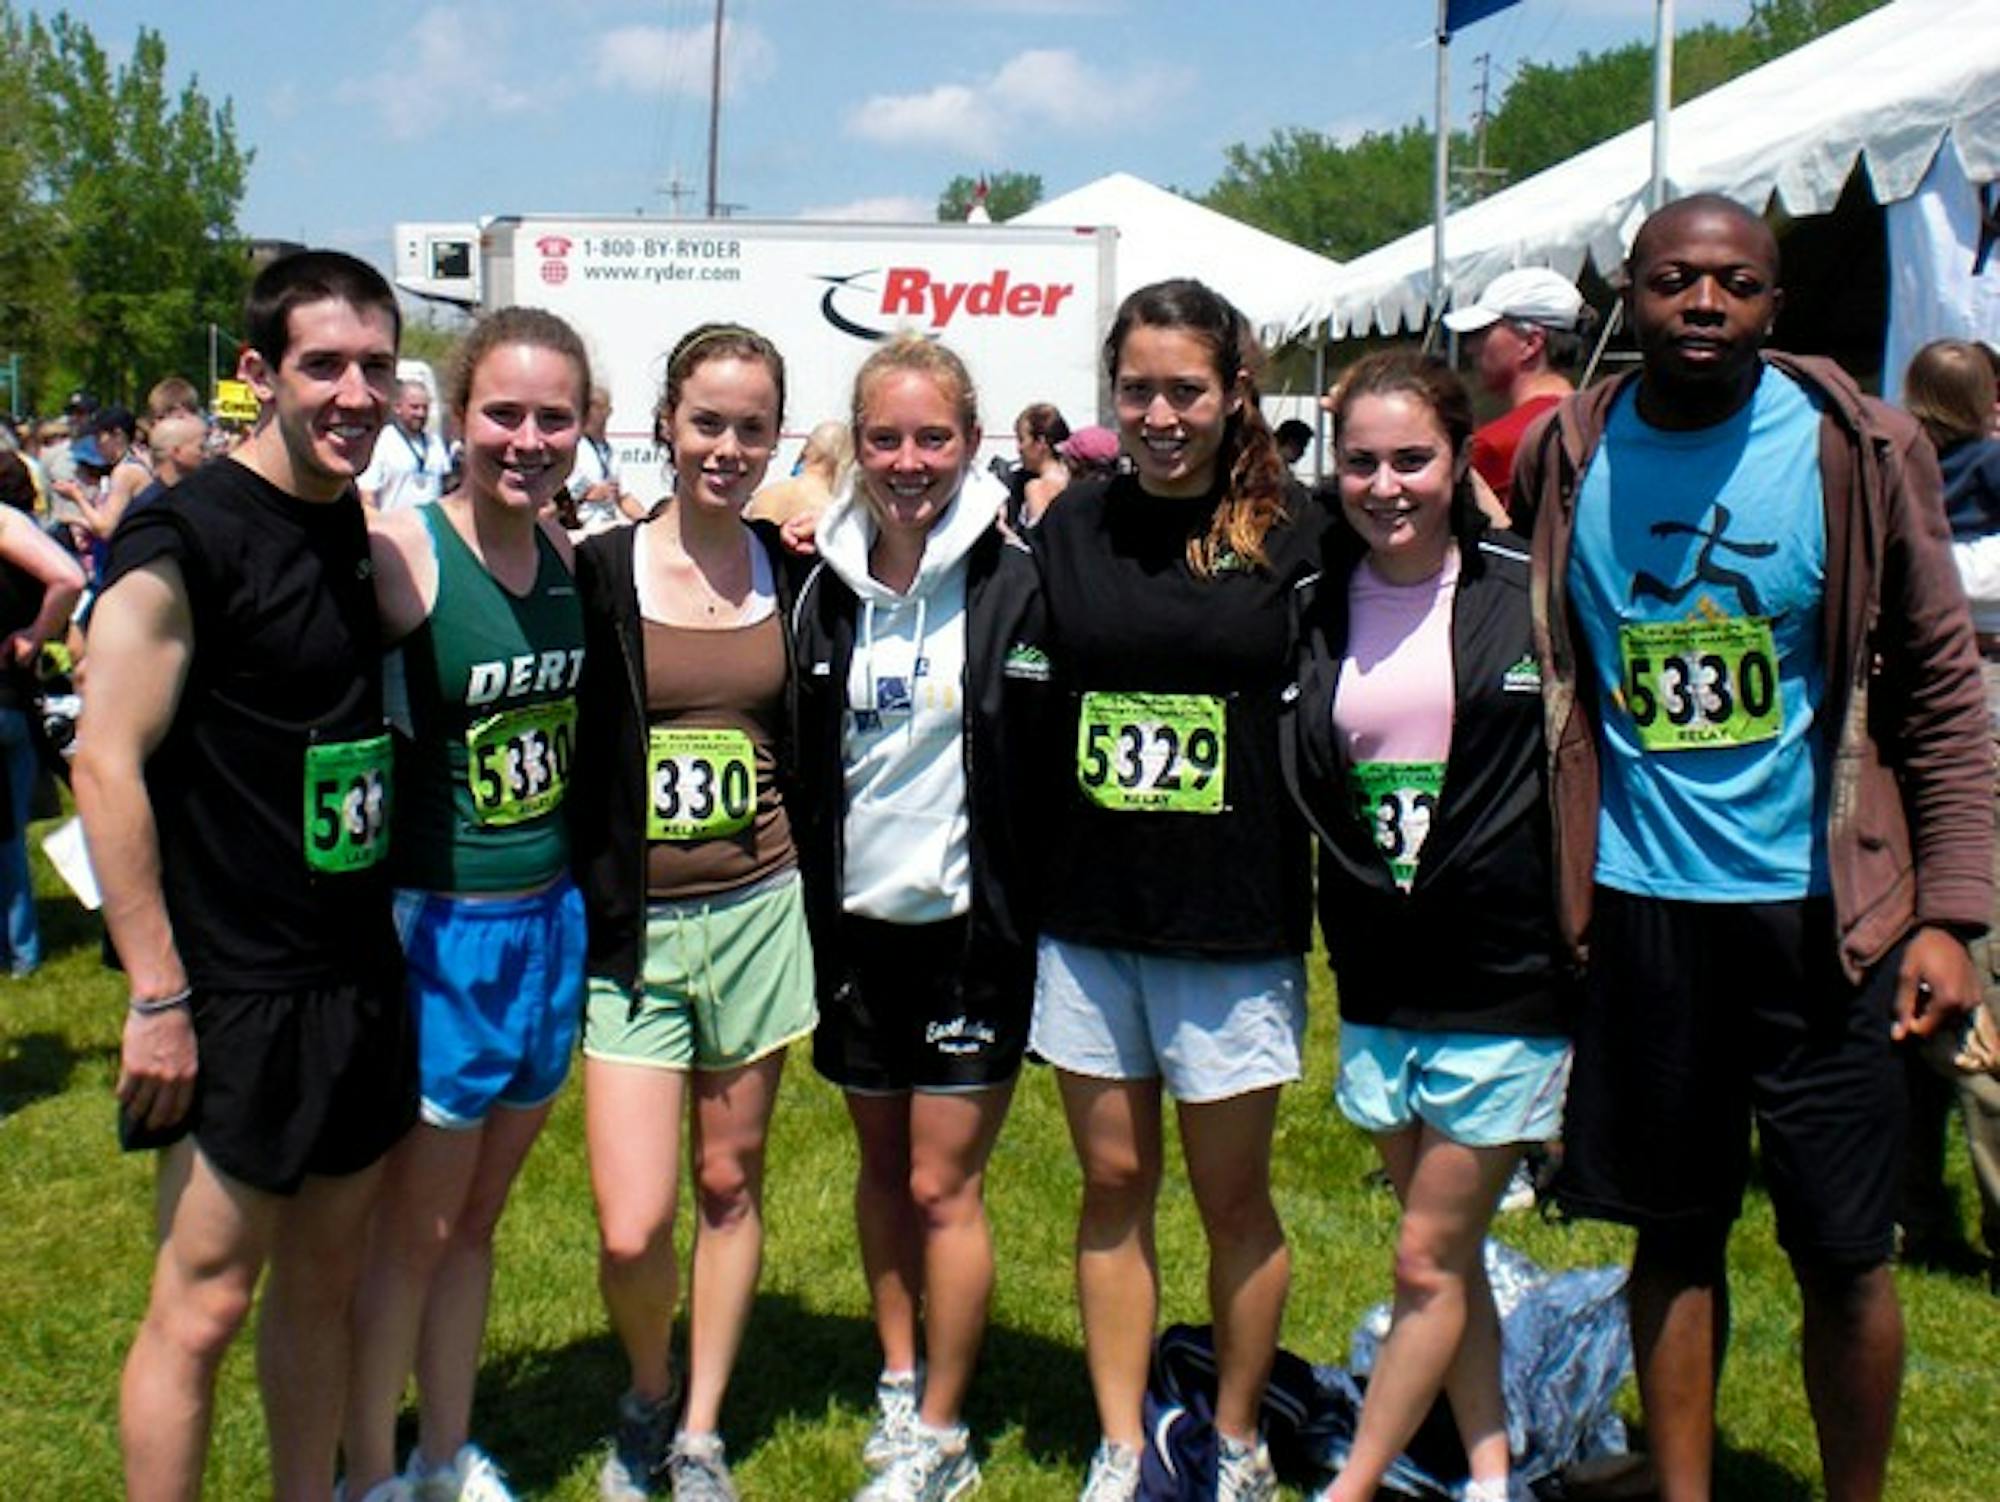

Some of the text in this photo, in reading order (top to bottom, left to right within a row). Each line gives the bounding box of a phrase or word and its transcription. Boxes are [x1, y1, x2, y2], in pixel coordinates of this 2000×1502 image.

[584, 262, 741, 284] www.ryder.com
[880, 267, 1074, 328] Ryder
[1628, 651, 1774, 727] 5330
[476, 724, 570, 806] 5330
[1082, 724, 1219, 790] 5329
